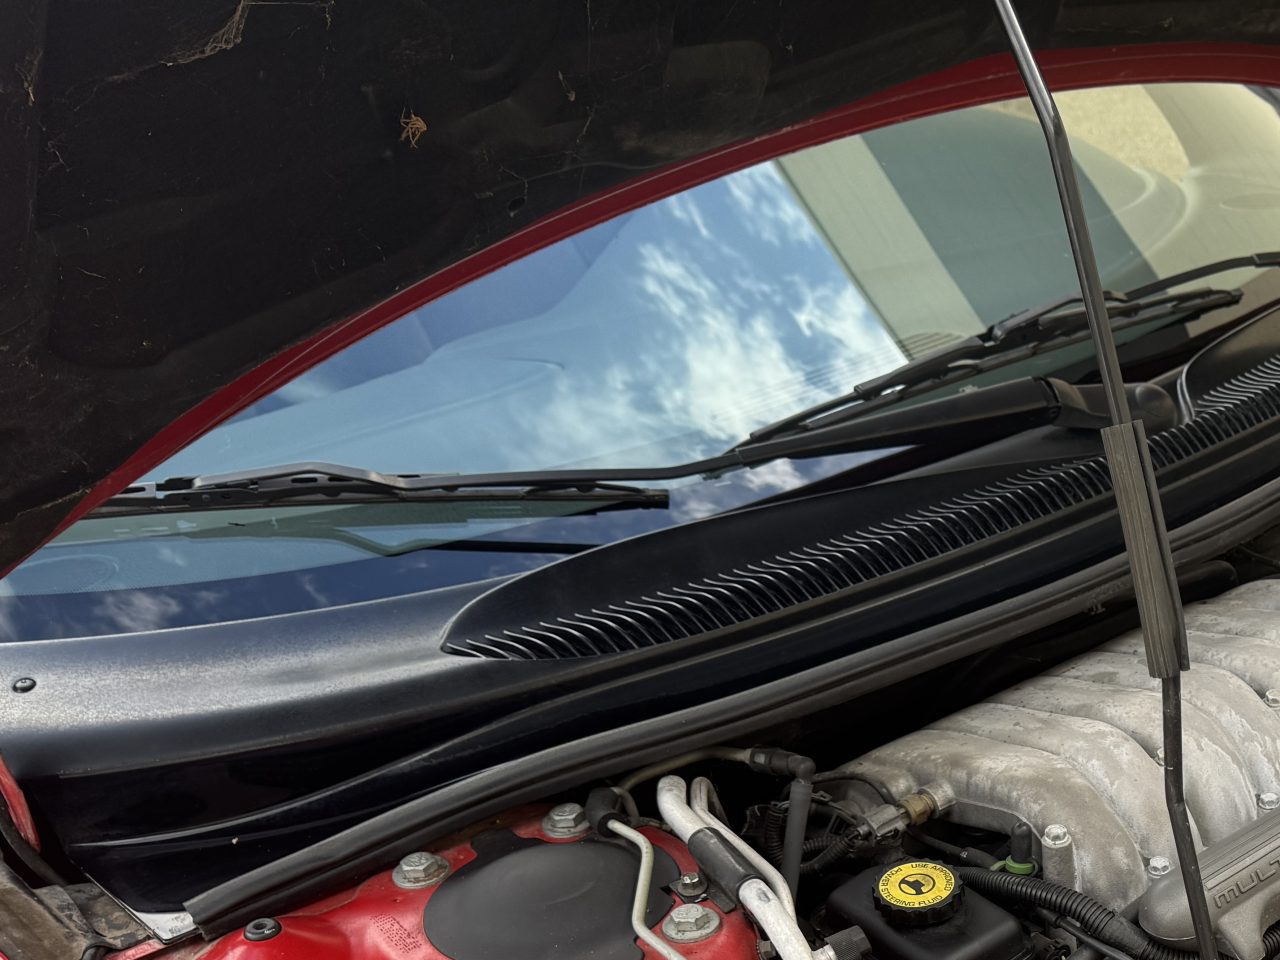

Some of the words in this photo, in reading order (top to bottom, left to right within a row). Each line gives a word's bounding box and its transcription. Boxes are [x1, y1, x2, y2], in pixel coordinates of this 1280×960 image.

[881, 867, 903, 887] POWER
[930, 865, 953, 892] APPROVED
[881, 887, 916, 906] STEERING
[918, 895, 943, 906] FLUID
